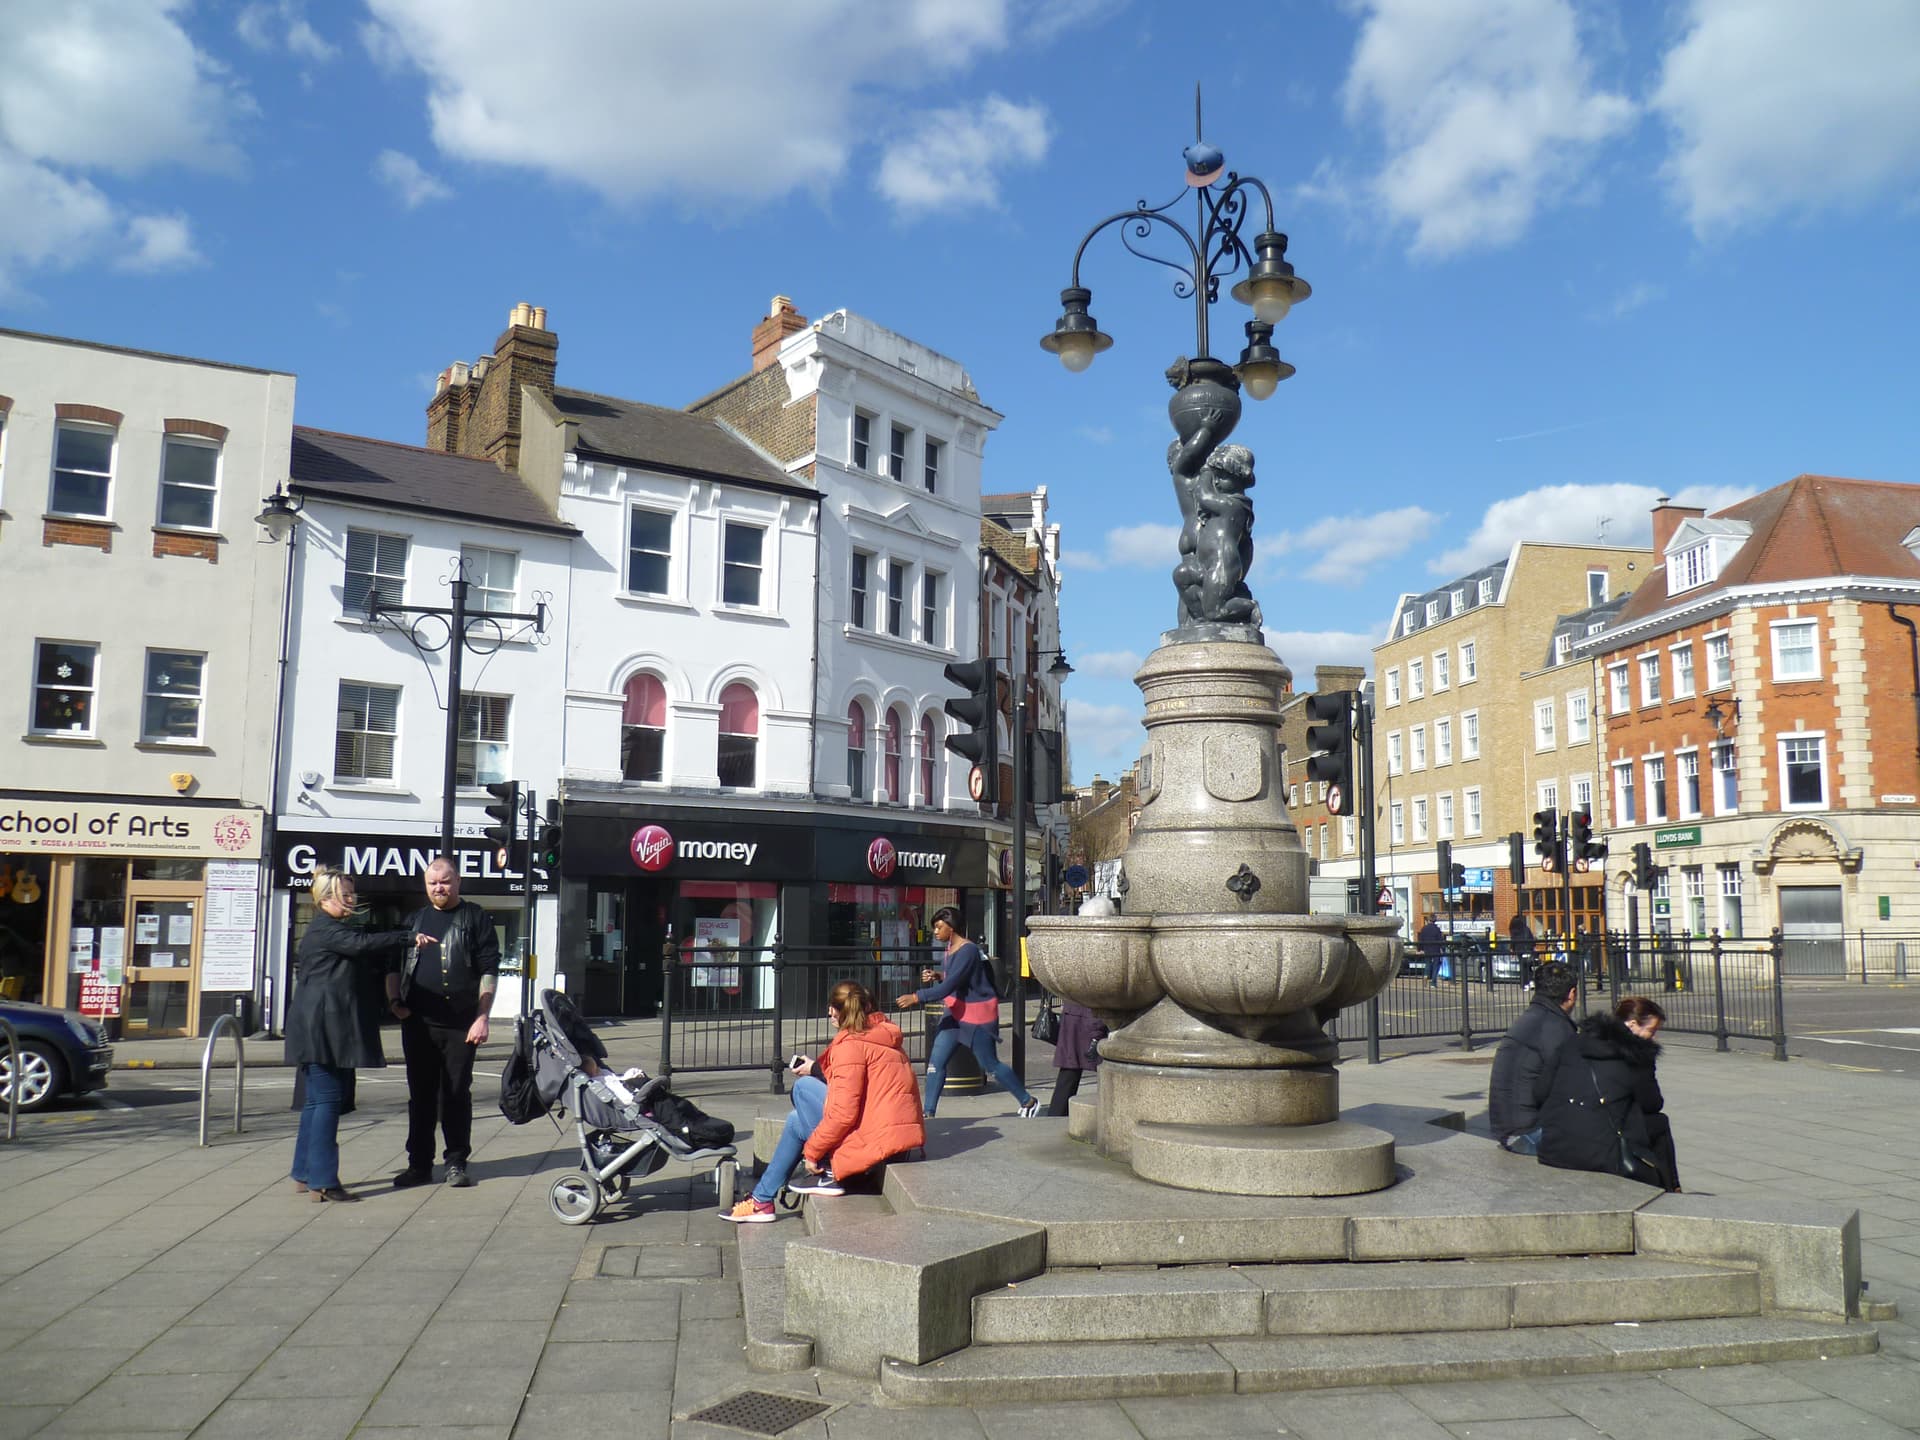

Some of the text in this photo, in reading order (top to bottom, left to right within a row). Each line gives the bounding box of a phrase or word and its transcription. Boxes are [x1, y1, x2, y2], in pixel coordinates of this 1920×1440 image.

[0, 810, 190, 837] chool of Arts
[636, 830, 758, 866] Virgin money
[1656, 831, 1695, 843] LLOYDS BANK
[287, 844, 549, 880] G MANELL
[897, 851, 947, 874] money
[531, 884, 549, 892] 982
